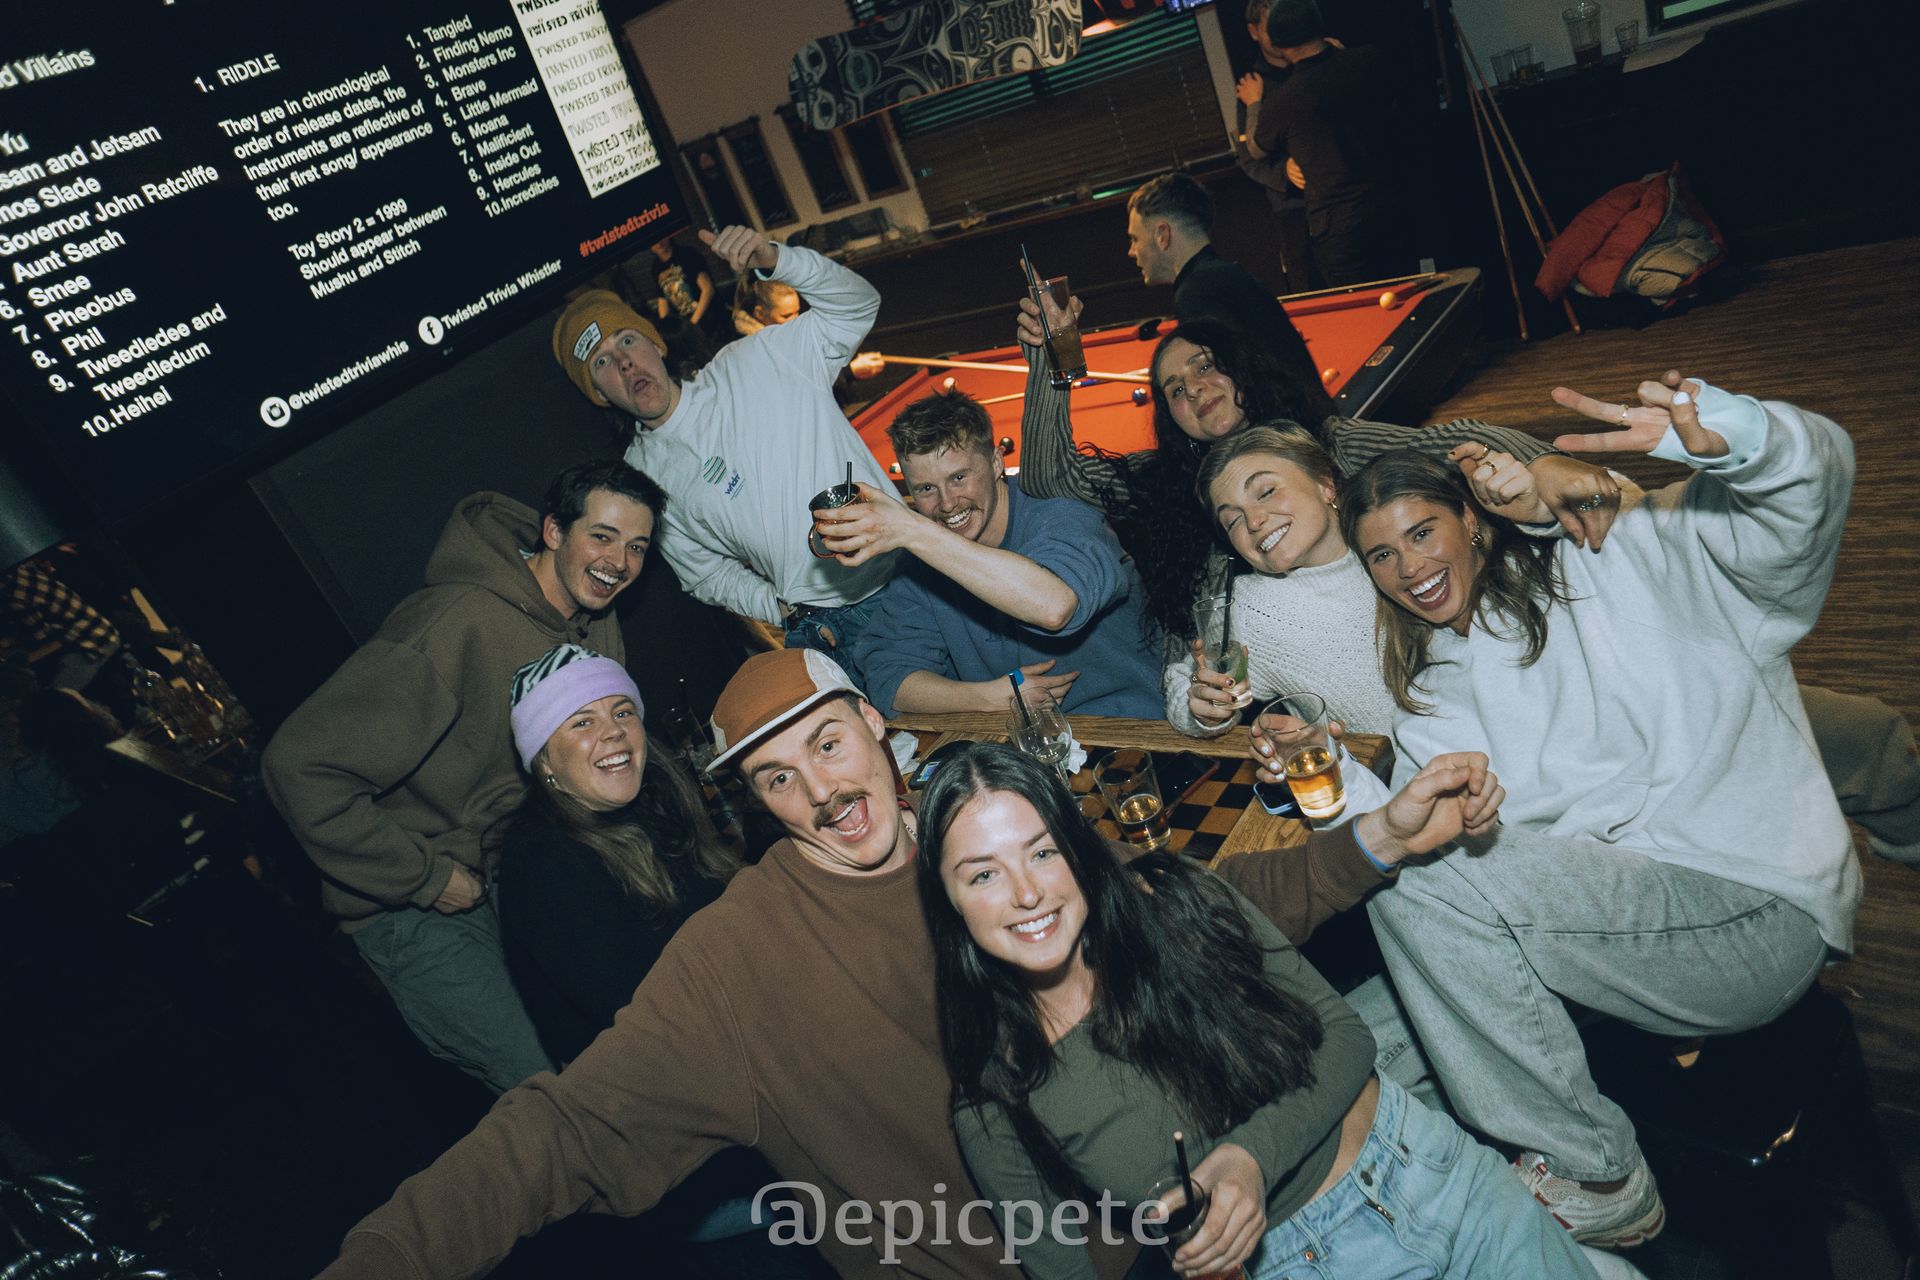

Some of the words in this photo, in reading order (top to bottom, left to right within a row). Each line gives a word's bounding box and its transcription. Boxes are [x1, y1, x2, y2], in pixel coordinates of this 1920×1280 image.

[406, 33, 421, 49] 1.
[423, 14, 473, 43] Tangled
[415, 54, 430, 70] 2.
[433, 35, 479, 63] Finding
[478, 24, 513, 47] Nemo
[536, 36, 578, 59] TWISTED
[13, 50, 96, 83] Villains
[194, 76, 215, 93] 1.
[217, 53, 281, 86] RIDDLE
[424, 74, 439, 89] 3.
[441, 53, 497, 83] Monsters
[497, 44, 517, 62] Inc
[545, 54, 587, 80] TWISTED
[552, 71, 596, 97] TWISTED
[218, 114, 259, 137] They
[260, 105, 286, 125] are
[284, 99, 302, 116] in
[301, 65, 391, 109] chronological
[434, 94, 448, 107] 4.
[450, 79, 487, 101] Brave
[442, 112, 456, 127] 5.
[459, 98, 490, 121] Little
[490, 78, 539, 107] Mermaid
[560, 92, 599, 117] TWISTED
[0, 130, 29, 155] Yu
[233, 136, 273, 159] order
[276, 125, 292, 144] of
[293, 110, 342, 139] release
[343, 95, 385, 119] dates,
[384, 86, 406, 105] the
[329, 130, 351, 148] are
[352, 108, 410, 139] reflective
[411, 99, 425, 116] of
[451, 132, 465, 146] 6.
[468, 114, 509, 139] Moana
[459, 150, 474, 165] 7.
[476, 122, 534, 158] Malificient
[45, 145, 90, 174] and
[90, 125, 162, 161] Jetsam
[256, 178, 290, 201] their
[290, 165, 321, 188] first
[321, 147, 358, 176] song/
[360, 122, 433, 161] appearance
[468, 167, 482, 183] 8.
[484, 151, 520, 176] Inside
[519, 140, 542, 160] Out
[38, 176, 101, 208] Slade
[476, 186, 490, 201] 9.
[492, 163, 542, 194] Hercules
[0, 209, 92, 255] Governor
[95, 190, 145, 223] John
[140, 164, 219, 204] Ratcliffe
[267, 202, 299, 222] too.
[288, 243, 316, 262] Toy
[316, 224, 353, 250] Story
[353, 218, 365, 233] 2
[375, 198, 408, 222] 1999
[579, 202, 670, 257] #twistedtrivia
[12, 250, 66, 284] Aunt
[63, 229, 126, 263] Sarah
[300, 250, 350, 280] Should
[350, 232, 395, 265] appear
[394, 205, 448, 237] between
[28, 275, 91, 307] Smee
[309, 271, 357, 300] Mushu
[358, 255, 384, 278] and
[383, 238, 422, 265] Stitch
[12, 324, 41, 345] 7.
[44, 287, 136, 333] Pheobus
[440, 296, 488, 330] Twisted
[486, 277, 519, 305] Trivia
[517, 259, 562, 290] Whistler
[31, 350, 58, 368] 8.
[61, 326, 106, 356] Phil
[49, 374, 74, 392] 9.
[77, 323, 191, 379] Tweedledee
[191, 303, 227, 331] and
[92, 340, 211, 401] Tweedledum
[288, 341, 409, 410] @twistedtriviawhis
